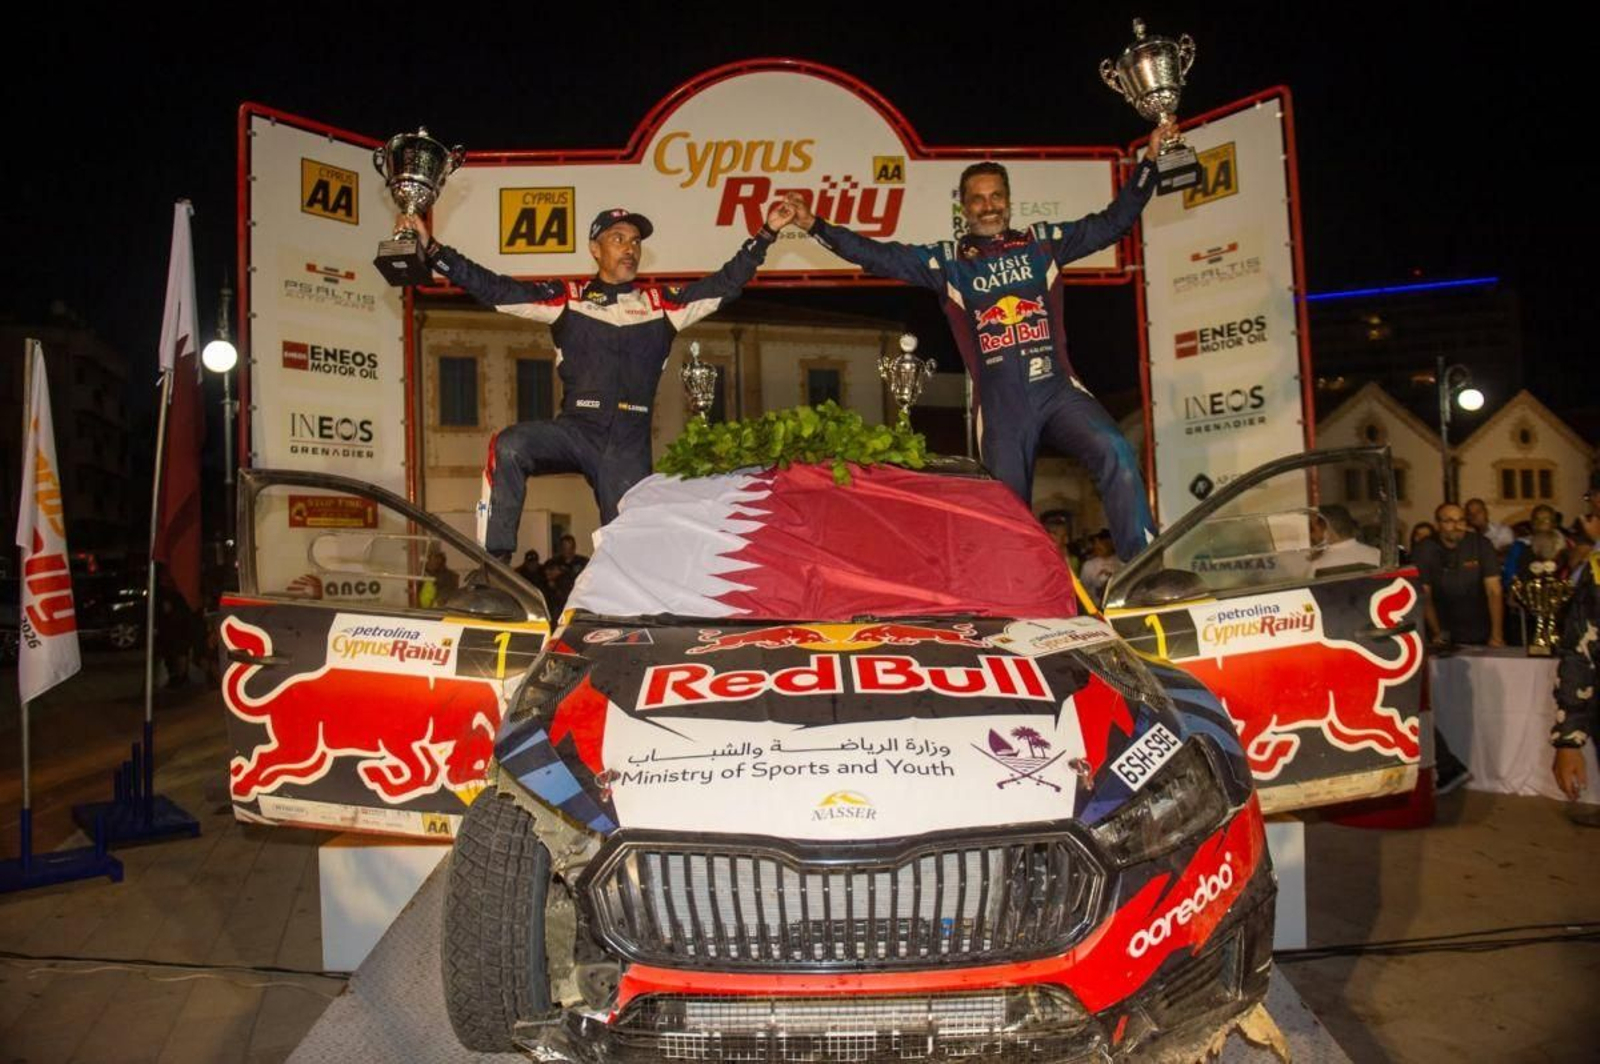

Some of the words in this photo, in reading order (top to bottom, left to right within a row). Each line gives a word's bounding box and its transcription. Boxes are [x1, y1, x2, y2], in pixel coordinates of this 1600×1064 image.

[654, 132, 815, 188] Cyprus
[877, 165, 902, 181] AA
[305, 179, 353, 218] AA
[522, 191, 569, 205] CYPRUS
[1020, 202, 1061, 217] EAST
[505, 207, 569, 246] AA
[973, 265, 1034, 292] QATAR
[284, 279, 375, 305] PSALTIS
[979, 325, 1017, 354] Red
[1016, 319, 1050, 344] Bull
[1199, 315, 1267, 344] ENEOS
[1201, 336, 1244, 353] MOTOR
[1247, 331, 1269, 345] OIL
[310, 344, 379, 369] ENEOS
[310, 361, 357, 377] MOTOR
[359, 367, 379, 380] OIL
[1184, 385, 1265, 420] INEOS
[290, 412, 374, 442] INEOS
[1185, 416, 1267, 435] GRENADIER
[290, 445, 374, 459] GRENADIER
[325, 580, 382, 597] anco
[1217, 602, 1281, 623] petrolina
[351, 624, 421, 640] petrolina
[1144, 614, 1170, 660] 1
[493, 631, 511, 678] 1
[637, 654, 843, 710] Red
[850, 654, 1056, 702] Bull
[905, 737, 950, 757] وزارة
[621, 765, 713, 785] Ministry
[721, 762, 747, 779] of
[752, 761, 829, 781] Sports
[837, 758, 878, 775] and
[885, 758, 955, 777] Youth
[811, 806, 877, 821] NASSER
[426, 820, 450, 834] AA
[1128, 862, 1233, 957] ooredoo
